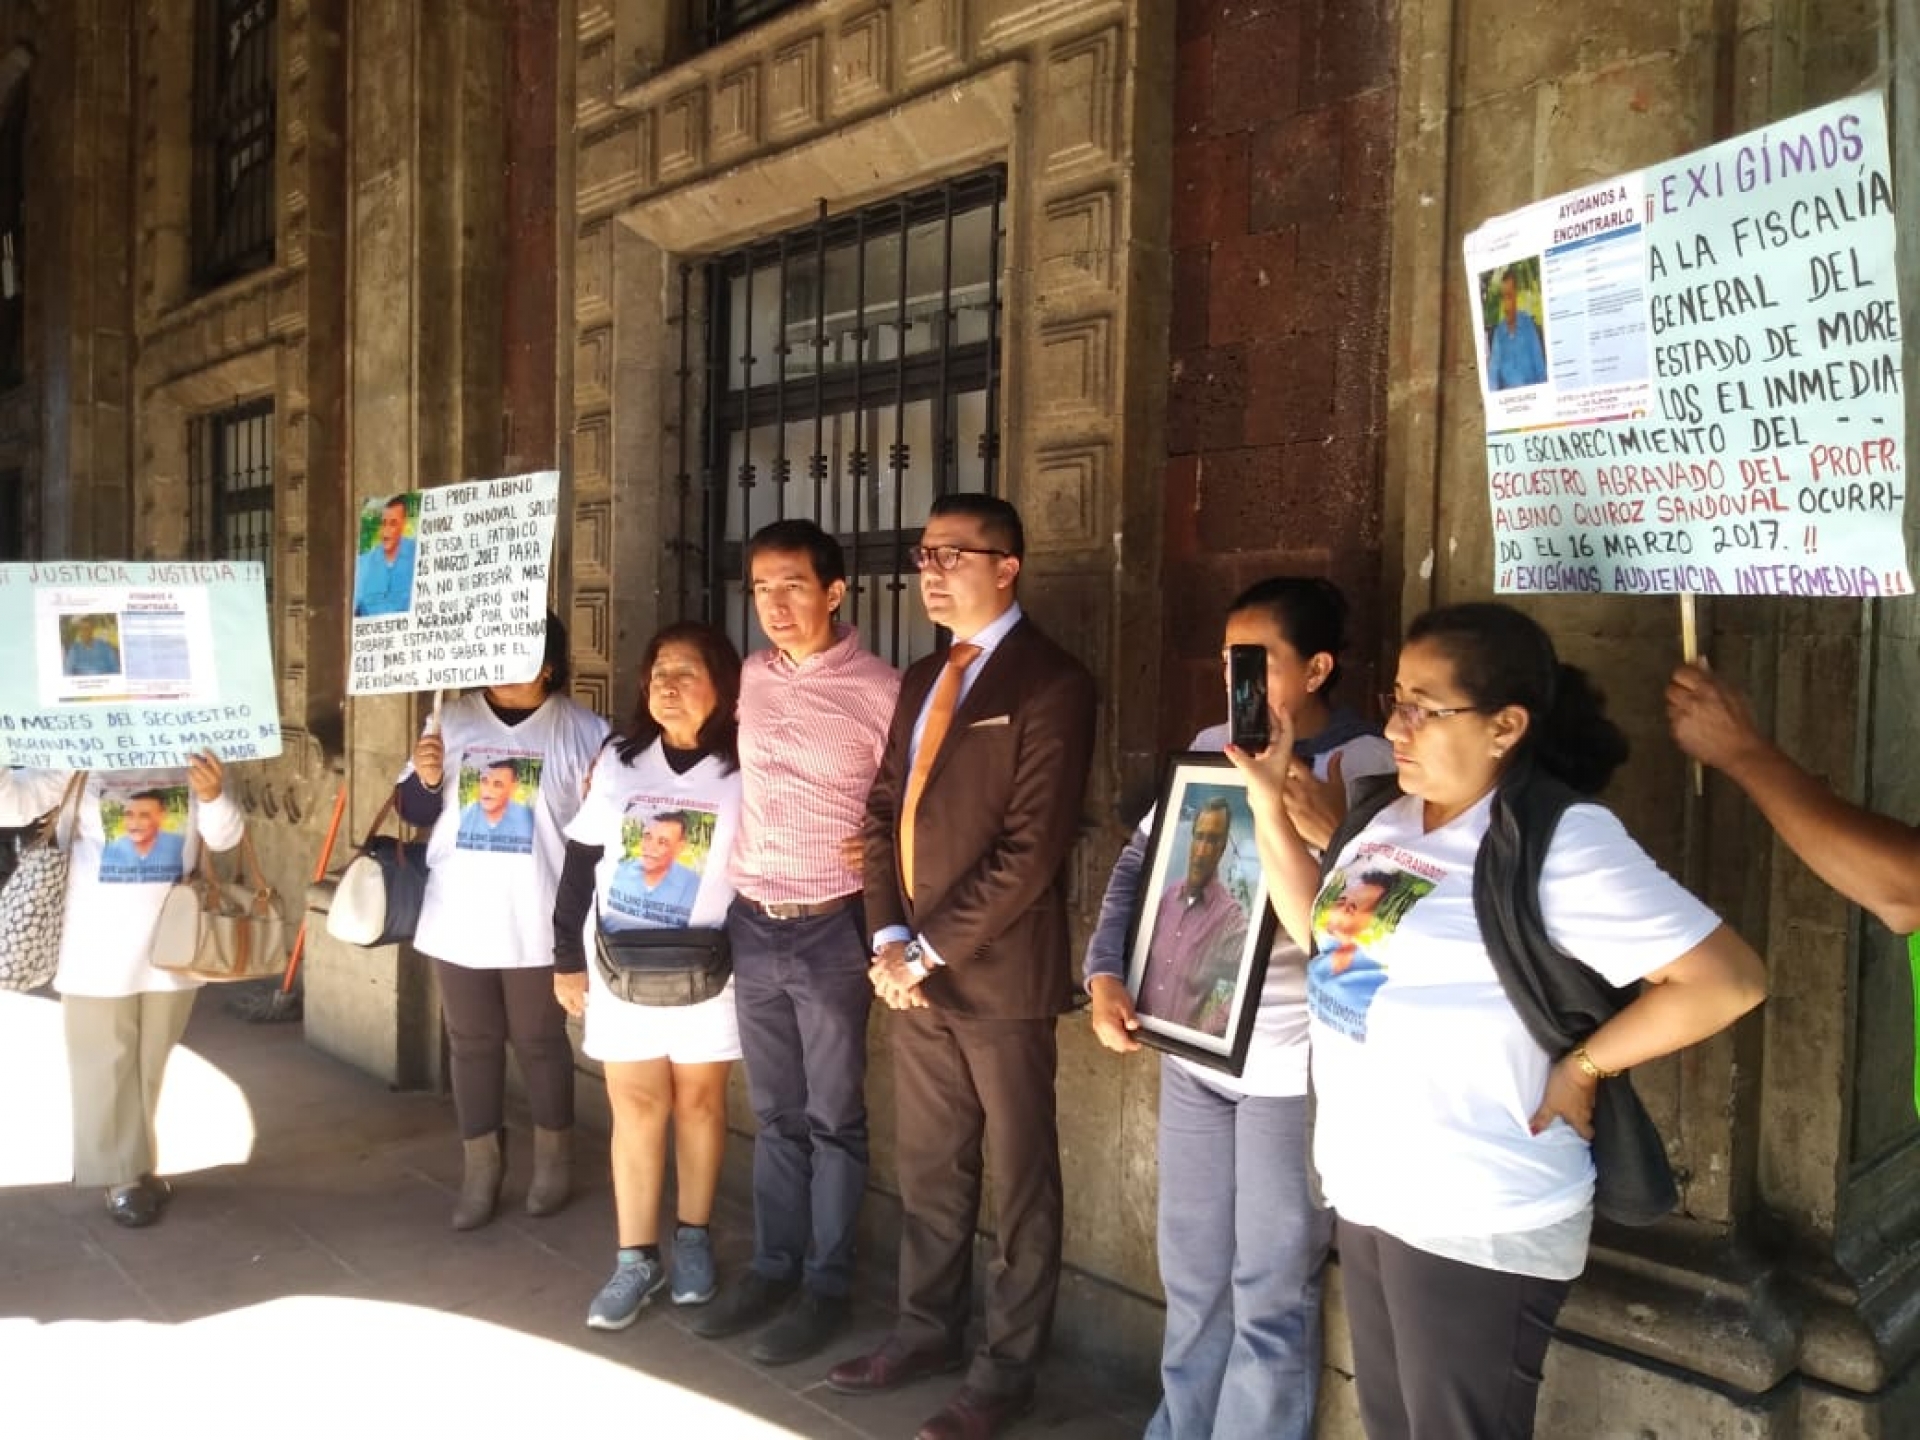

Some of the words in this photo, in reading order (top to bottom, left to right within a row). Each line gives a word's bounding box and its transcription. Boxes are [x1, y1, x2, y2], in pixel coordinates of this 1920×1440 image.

[1558, 188, 1615, 219] AYUDANOS
[1618, 185, 1627, 200] A
[1553, 208, 1634, 244] ENCONTRARLO
[1650, 244, 1667, 282] A
[1675, 233, 1717, 270] LA
[1732, 163, 1895, 258] FISCALÍA
[1650, 273, 1779, 336] GENERAL
[1807, 247, 1875, 303] DEL
[1655, 334, 1751, 377] ESTADO
[1762, 324, 1802, 362] DE
[1659, 383, 1703, 424] LOS
[1717, 381, 1754, 414] EL
[1488, 442, 1516, 466] TO
[1524, 425, 1726, 463] ESCLARECIMIENTO
[1751, 416, 1809, 453] DEL
[1492, 468, 1587, 500] SECUESTRO
[1597, 459, 1725, 496] AGRAVADO
[1739, 455, 1790, 490] DEL
[1809, 437, 1901, 482] PROFR.
[424, 495, 437, 512] EL
[487, 478, 532, 499] ALBINO
[1496, 503, 1562, 532] ALBINO
[1574, 499, 1645, 527] QUIROZ
[1657, 487, 1790, 524] SANDOVAL
[463, 506, 517, 528] SANDOVAL
[434, 552, 469, 573] MARZO
[509, 541, 541, 561] PARA
[435, 536, 462, 552] CASA
[471, 533, 479, 548] EL
[1500, 539, 1522, 563] DO
[1533, 536, 1561, 557] EL
[1569, 533, 1595, 558] 16
[1603, 529, 1693, 558] MARZO
[29, 563, 133, 584] JUSTICIA
[148, 564, 236, 584] JUSTICIA
[437, 578, 453, 594] NO
[458, 565, 512, 591] REGRESAR
[1614, 565, 1725, 593] AUDIENCIA
[511, 587, 528, 603] UN
[416, 610, 473, 629] AGRAVADO
[481, 607, 502, 623] POR
[510, 605, 528, 621] UN
[475, 618, 547, 639] CUMPLIENDO
[428, 646, 446, 661] NO
[450, 643, 488, 660] SABER
[426, 665, 488, 685] JUSTICIA
[21, 714, 93, 731] MESES
[107, 712, 133, 727] DEL
[142, 704, 251, 726] SECUESTRO
[117, 736, 141, 748] EL
[179, 728, 249, 744] MARZO
